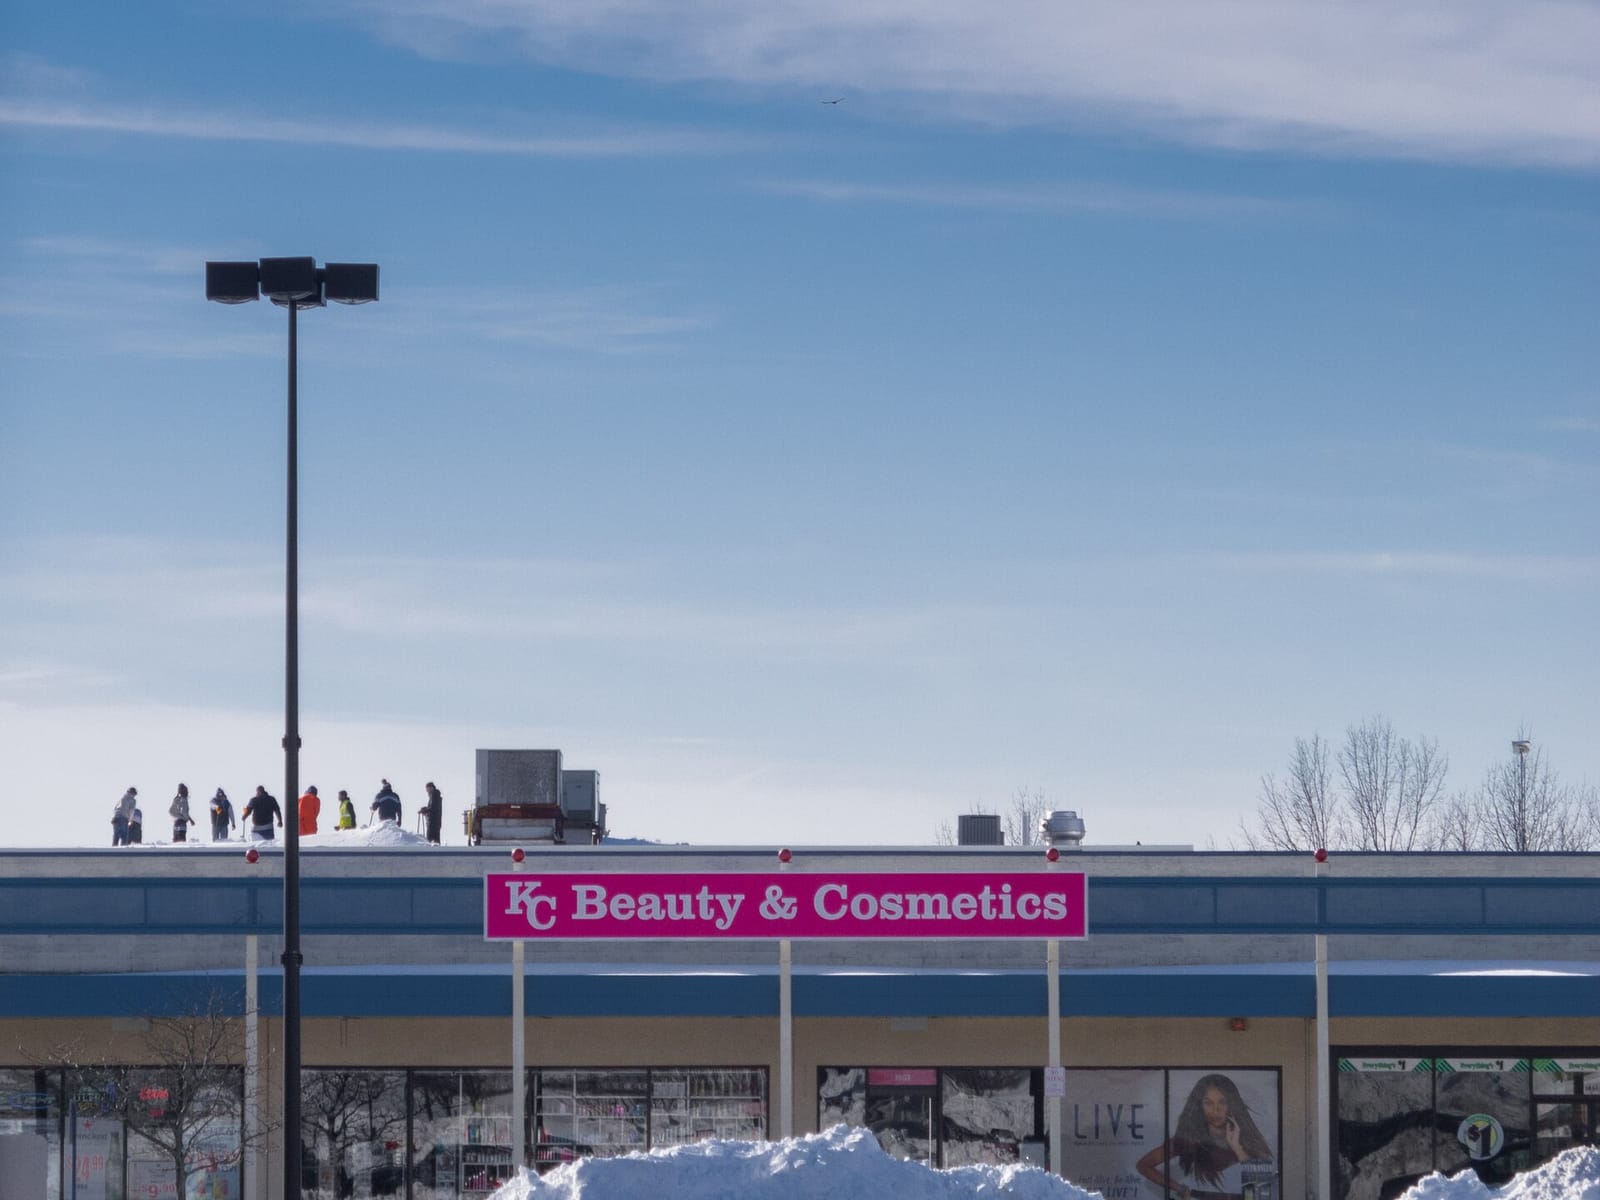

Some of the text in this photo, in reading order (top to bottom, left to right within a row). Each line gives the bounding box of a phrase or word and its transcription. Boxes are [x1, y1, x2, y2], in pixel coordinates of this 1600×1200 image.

[505, 881, 1068, 930] KC Beauty & Cosmetics
[1074, 1103, 1144, 1139] LIVE
